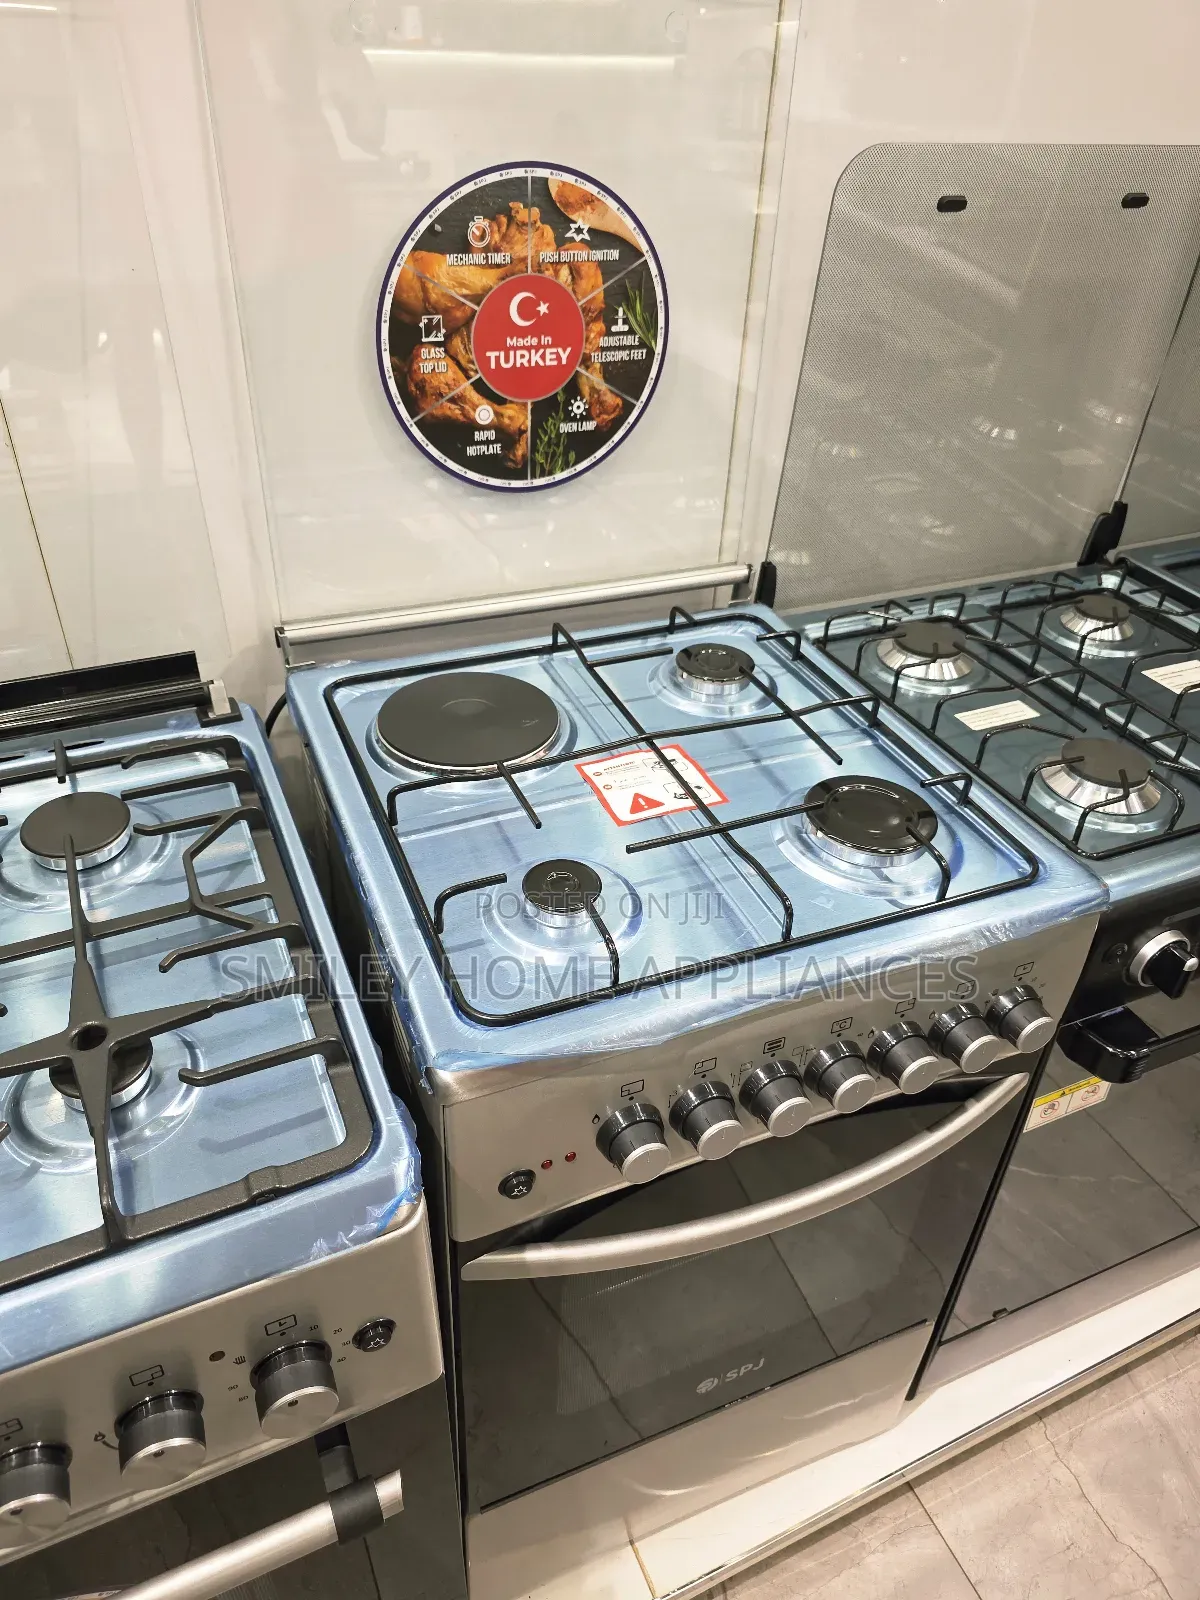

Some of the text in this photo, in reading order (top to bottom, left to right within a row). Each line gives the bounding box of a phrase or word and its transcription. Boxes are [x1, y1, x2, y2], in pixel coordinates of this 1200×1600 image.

[446, 252, 512, 266] MECHANIC TIMER
[539, 249, 620, 263] PUSH BUTTON IGNITION
[506, 335, 552, 348] Made In
[599, 334, 640, 348] ADJUSTABLE
[421, 347, 445, 360] GLASS
[485, 346, 572, 370] TURKEY
[590, 350, 630, 363] TELESCOPIC
[630, 348, 647, 361] FEET
[419, 361, 447, 374] TOP LID
[559, 420, 597, 434] OVEN LAMP
[474, 429, 496, 442] RAPID
[466, 443, 502, 457] HOTPLATE
[309, 1324, 319, 1332] 10
[724, 1357, 765, 1383] SPJ
